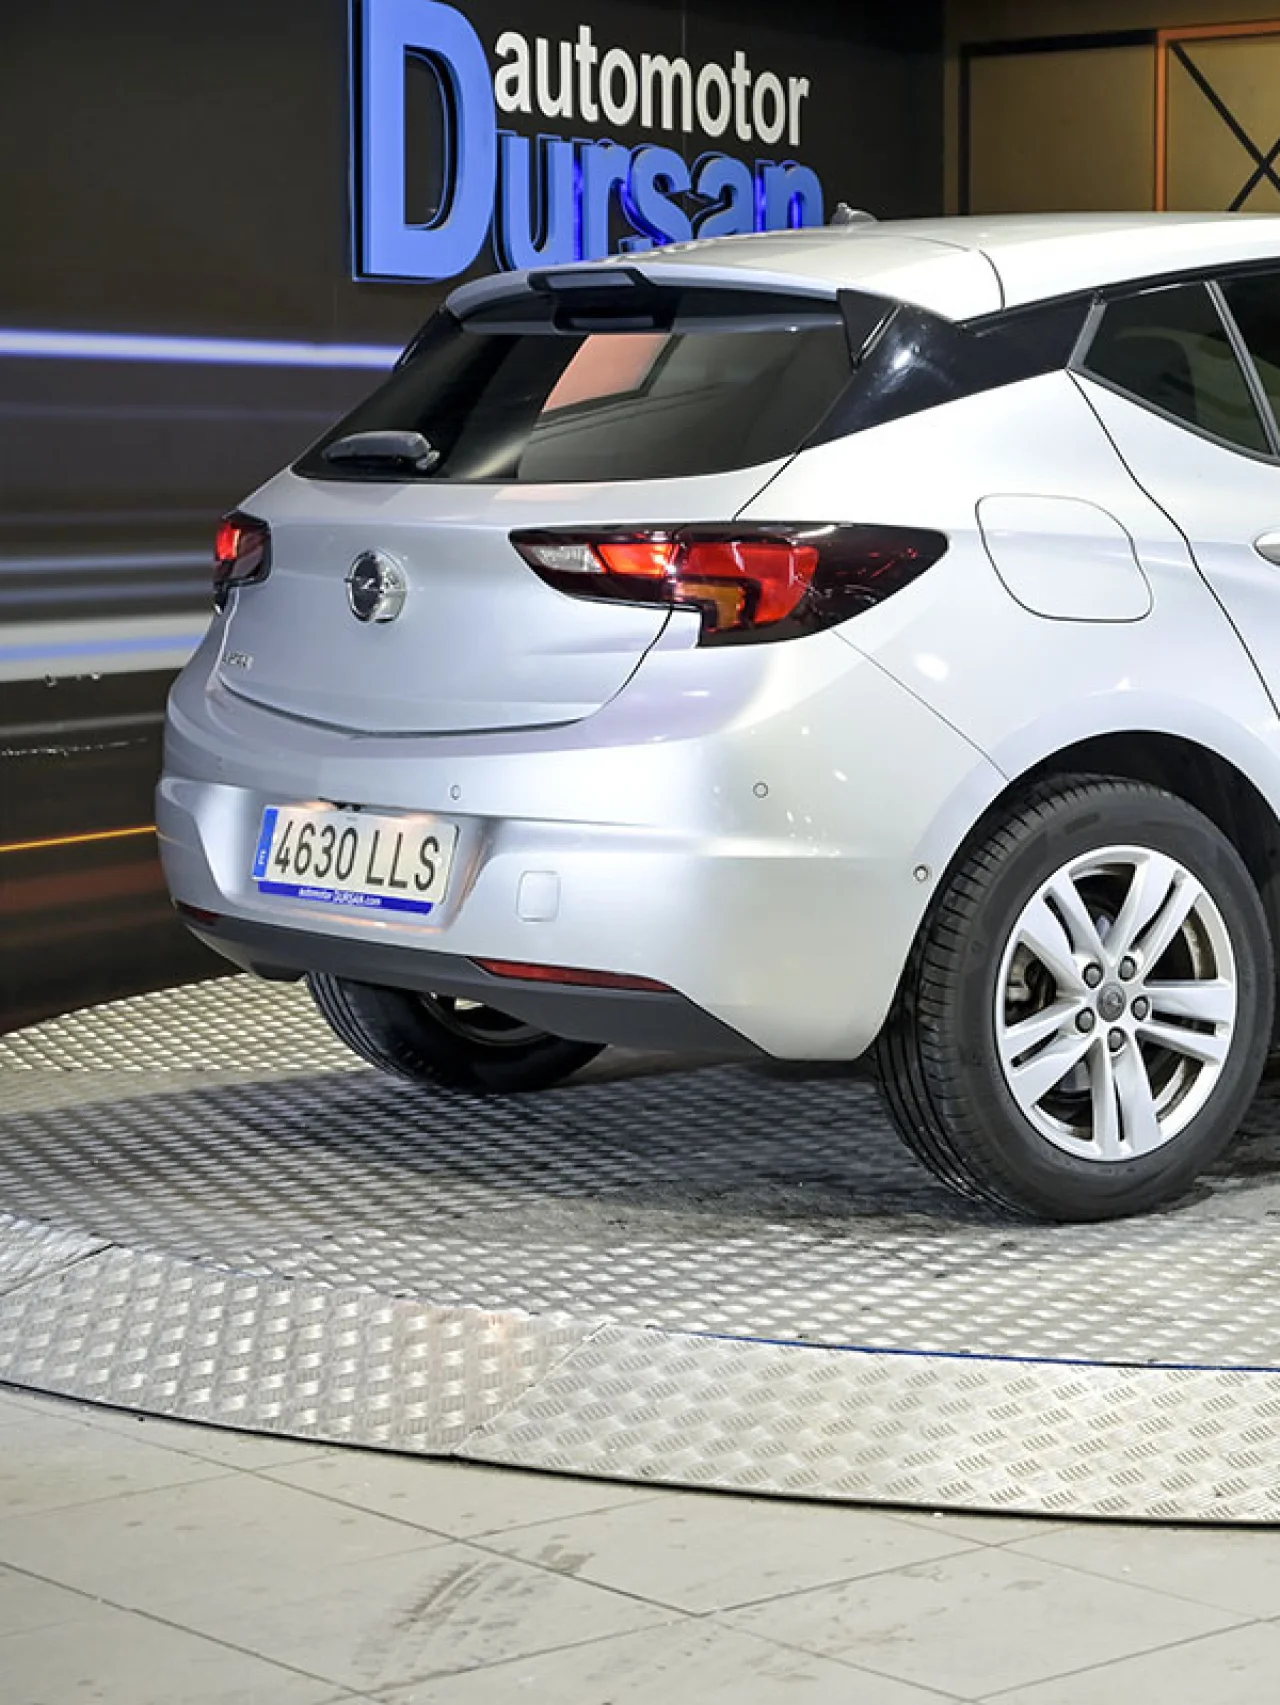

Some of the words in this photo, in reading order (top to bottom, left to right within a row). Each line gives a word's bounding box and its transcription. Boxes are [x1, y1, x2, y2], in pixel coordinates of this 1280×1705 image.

[351, 0, 824, 283] Dursan
[495, 25, 809, 146] automotor
[274, 820, 360, 881] 4630
[365, 829, 440, 891] LLS
